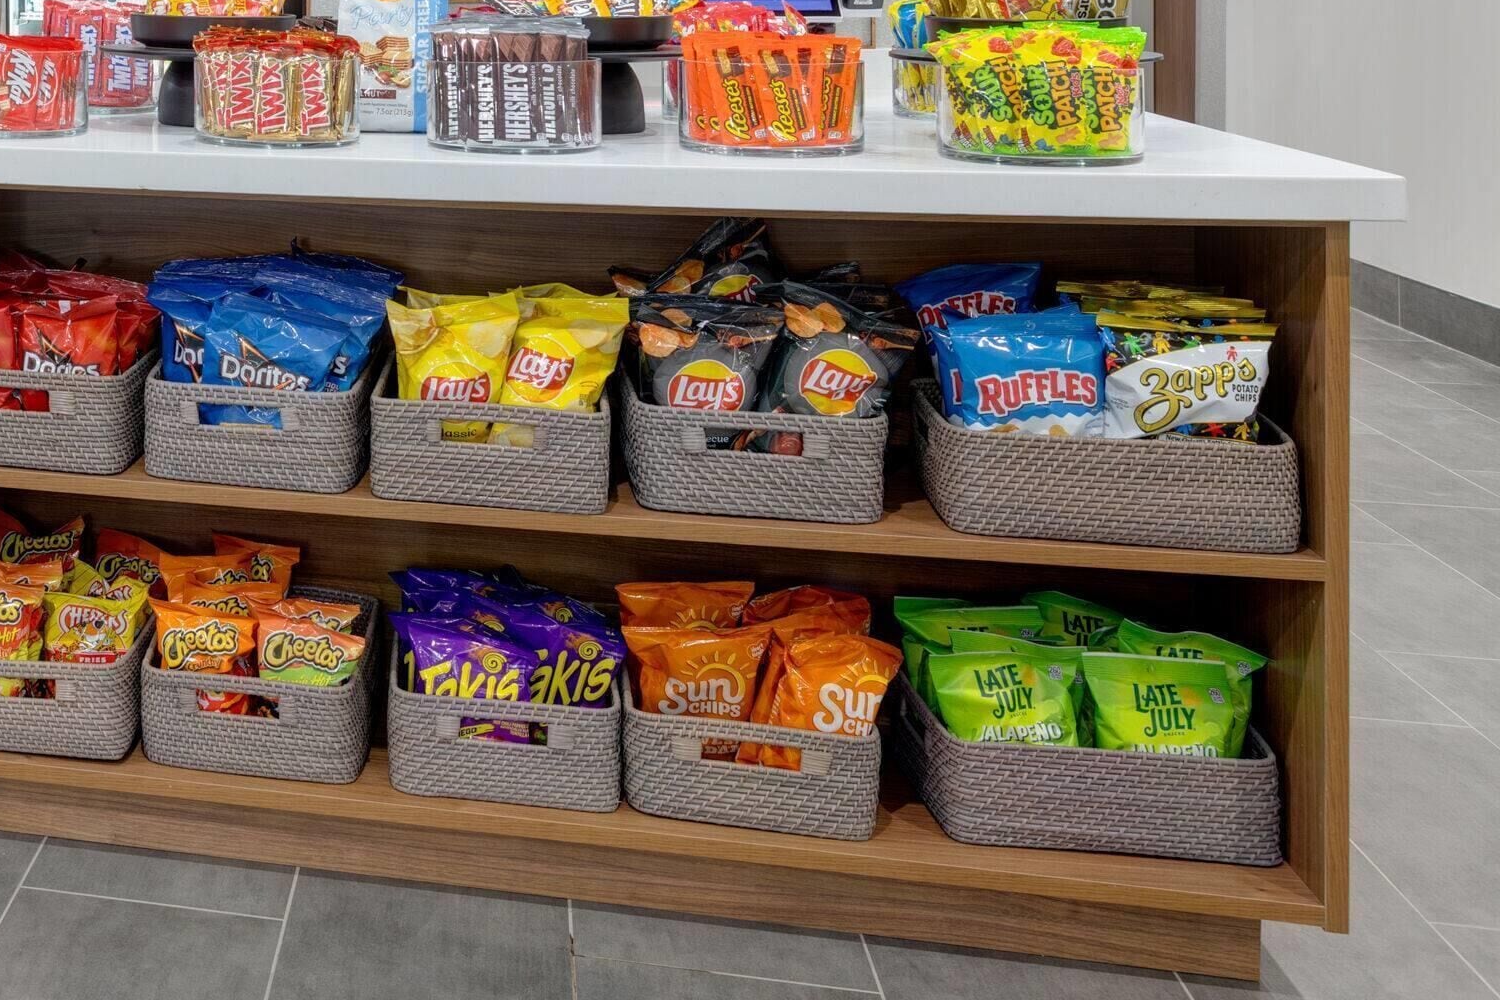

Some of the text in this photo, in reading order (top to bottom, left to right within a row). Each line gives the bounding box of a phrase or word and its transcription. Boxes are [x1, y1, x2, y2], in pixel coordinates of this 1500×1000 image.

[350, 4, 416, 30] Party
[415, 0, 430, 94] SUGAR FREE
[225, 56, 256, 131] TWIX
[256, 62, 288, 136] TWIX
[301, 59, 331, 136] TWIX
[478, 64, 495, 141] HERSHEY'S
[504, 63, 531, 140] HERSHEY'S
[724, 78, 752, 140] Reese's
[770, 79, 799, 142] Reese's
[975, 63, 1011, 122] SOUR
[1026, 62, 1054, 126] SOUR
[1050, 60, 1077, 129] PATCH
[1099, 66, 1122, 132] PATCH
[23, 352, 100, 377] Doritos
[221, 355, 310, 391] Doritos
[507, 347, 574, 389] Lay's
[803, 361, 876, 400] Lay's
[422, 376, 487, 401] Lay's
[673, 375, 741, 409] Lay's
[977, 368, 1098, 416] RUFFLES
[1133, 357, 1257, 434] Zapp's
[1232, 384, 1259, 394] POTATO
[1234, 392, 1257, 403] CHIPS
[442, 428, 477, 438] lassic
[1062, 611, 1105, 636] LATE
[79, 655, 107, 664] FRIES
[163, 621, 238, 668] Cheetos
[264, 632, 346, 673] Cheetos
[420, 661, 521, 701] Takis
[531, 649, 616, 706] akis
[657, 676, 746, 715] Sun
[974, 664, 1023, 699] LATE
[688, 701, 742, 718] CHIPS
[993, 688, 1036, 719] JULY
[1132, 684, 1182, 714] LATE
[980, 721, 1063, 744] JALAPEÑO
[1144, 708, 1197, 738] JULY
